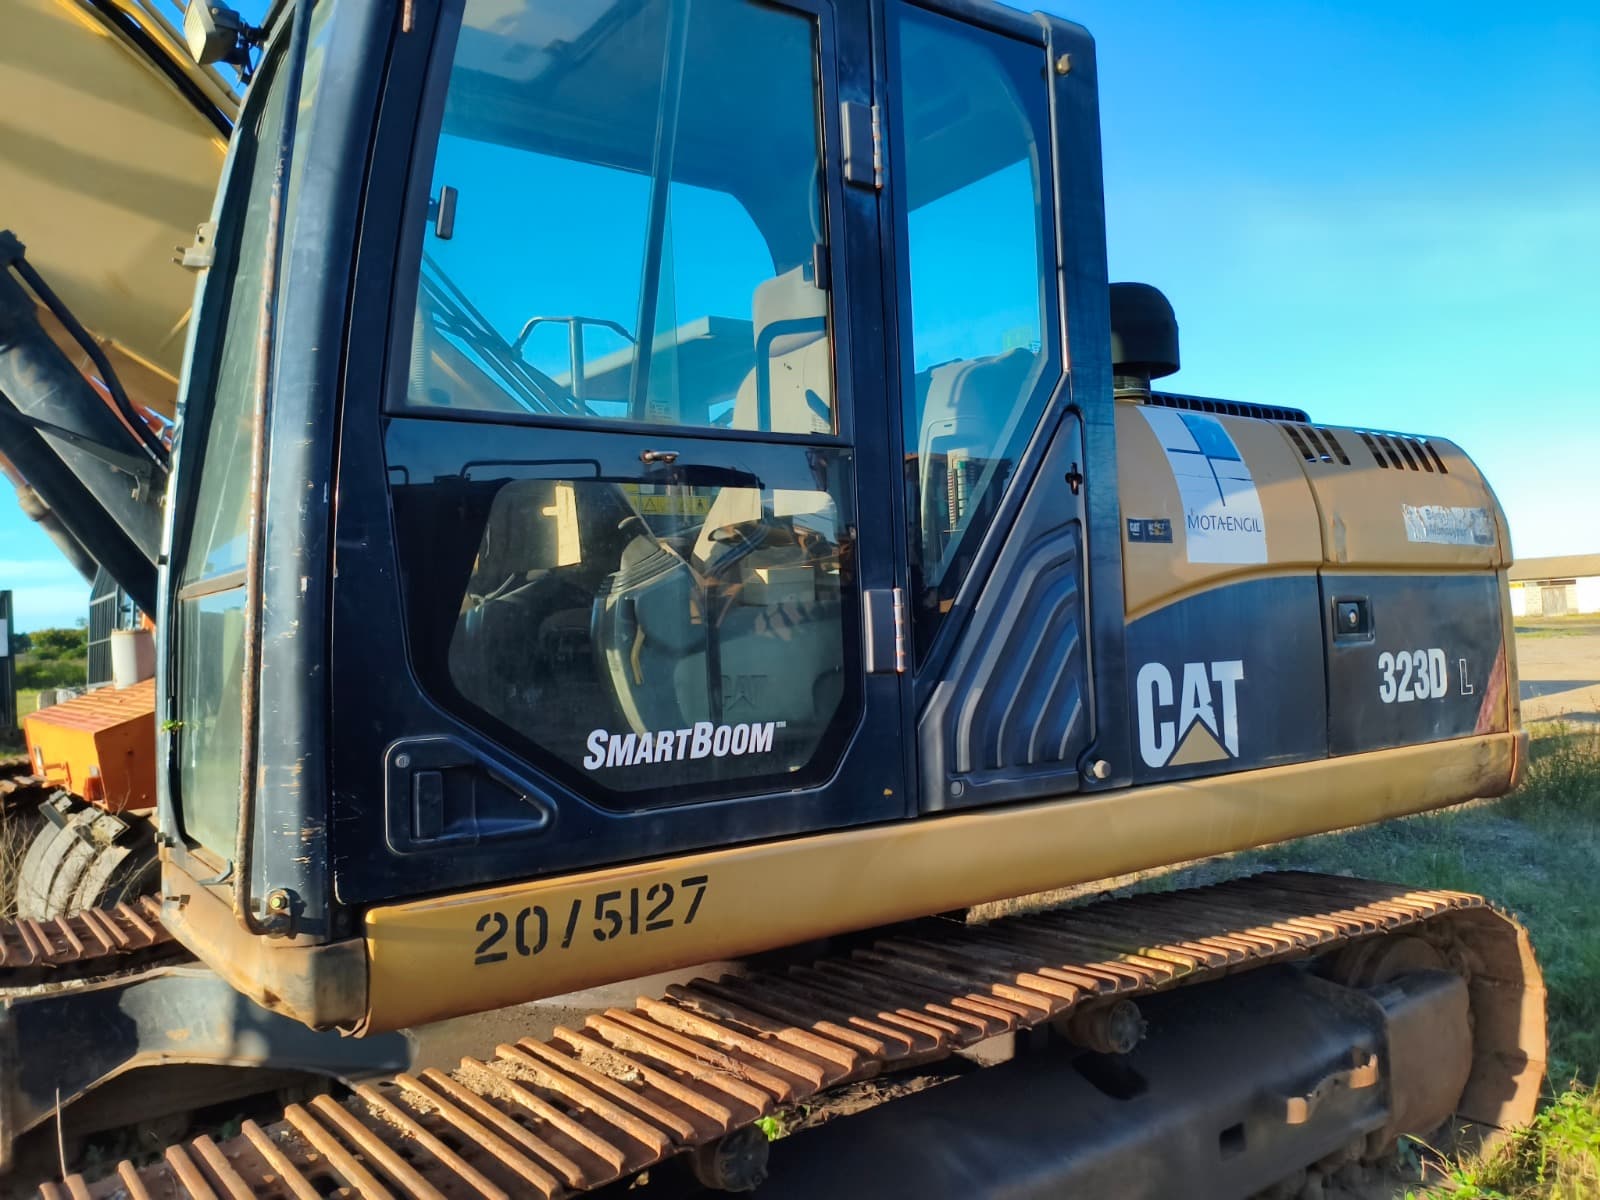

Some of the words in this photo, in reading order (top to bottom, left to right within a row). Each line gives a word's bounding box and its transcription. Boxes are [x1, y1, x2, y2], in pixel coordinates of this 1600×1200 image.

[1136, 660, 1244, 768] CAT
[1378, 648, 1448, 703] 323D
[1459, 658, 1473, 695] L
